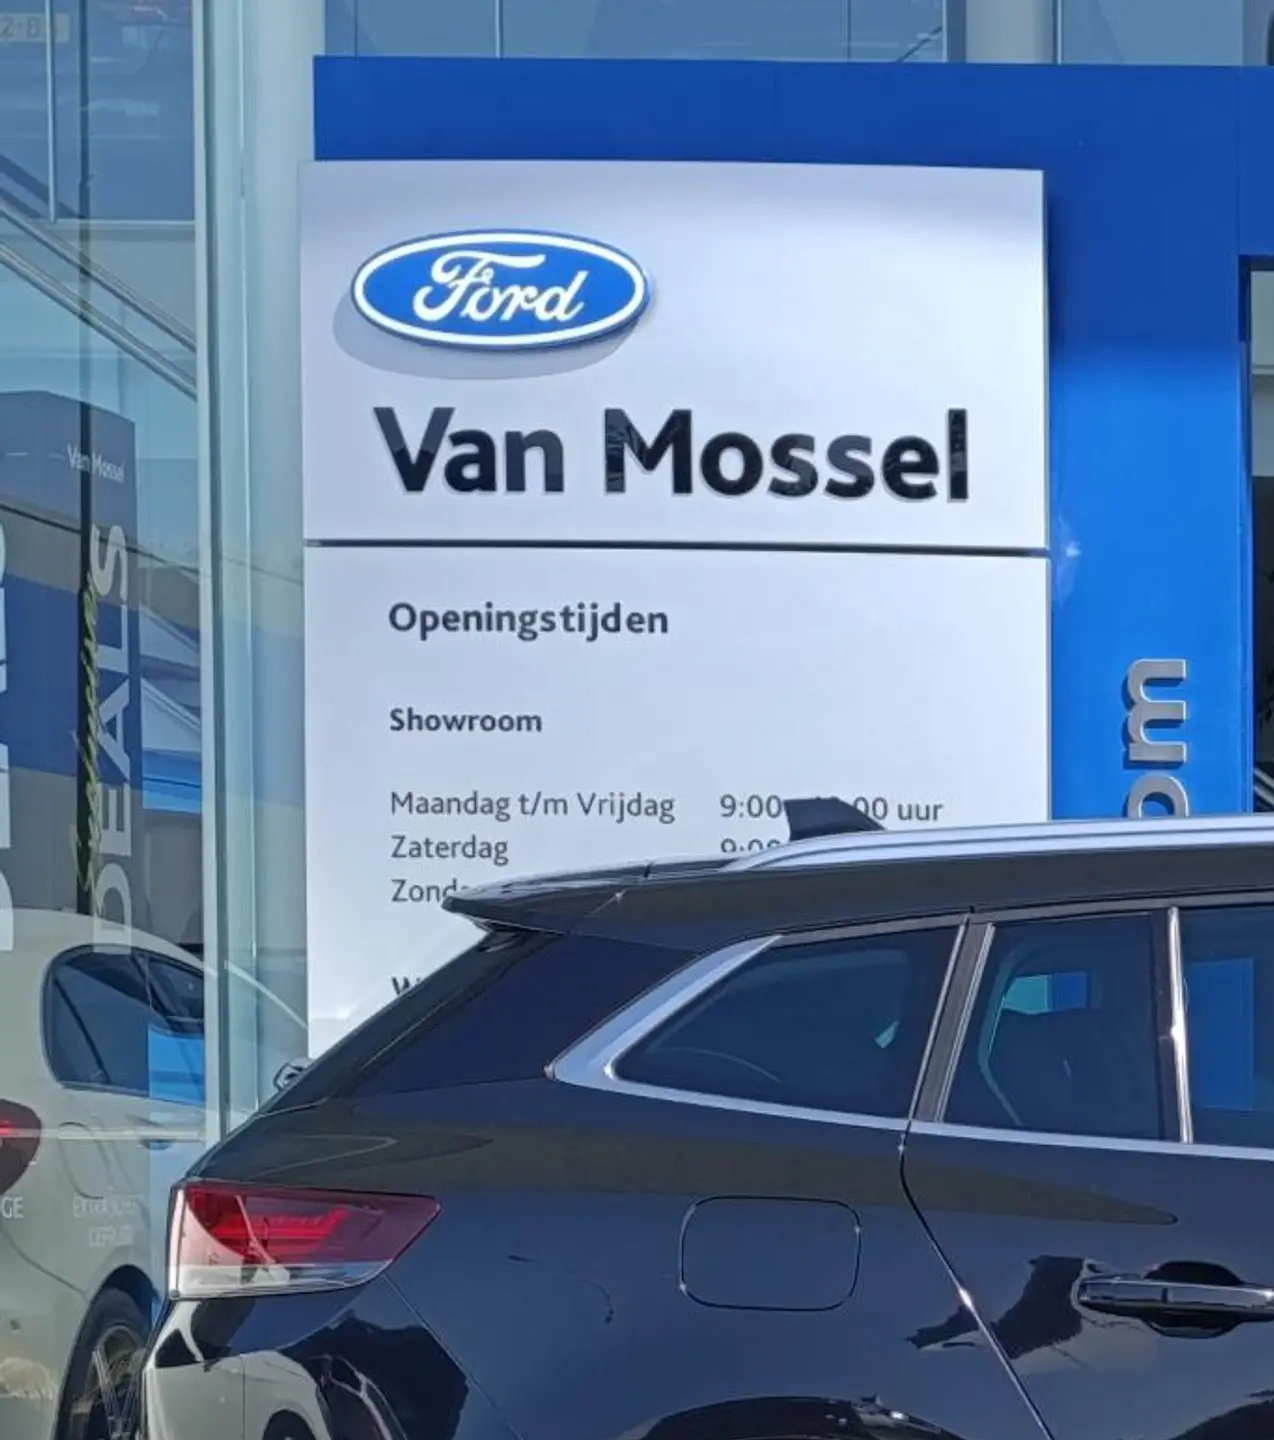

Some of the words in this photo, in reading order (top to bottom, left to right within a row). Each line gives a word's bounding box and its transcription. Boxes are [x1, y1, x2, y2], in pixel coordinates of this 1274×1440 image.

[413, 250, 590, 323] Ford
[373, 406, 565, 494] Van
[603, 407, 970, 503] Mossel
[388, 600, 669, 643] Openingstijden
[389, 706, 543, 733] Showroom
[90, 523, 132, 954] DEALS
[390, 790, 511, 823] Maandag
[519, 791, 568, 816] t/m
[576, 791, 676, 824] Vrijdag
[720, 793, 782, 818] 9:00
[897, 803, 944, 822] uur
[390, 834, 509, 867] Zaterdag
[390, 878, 470, 904] Zond
